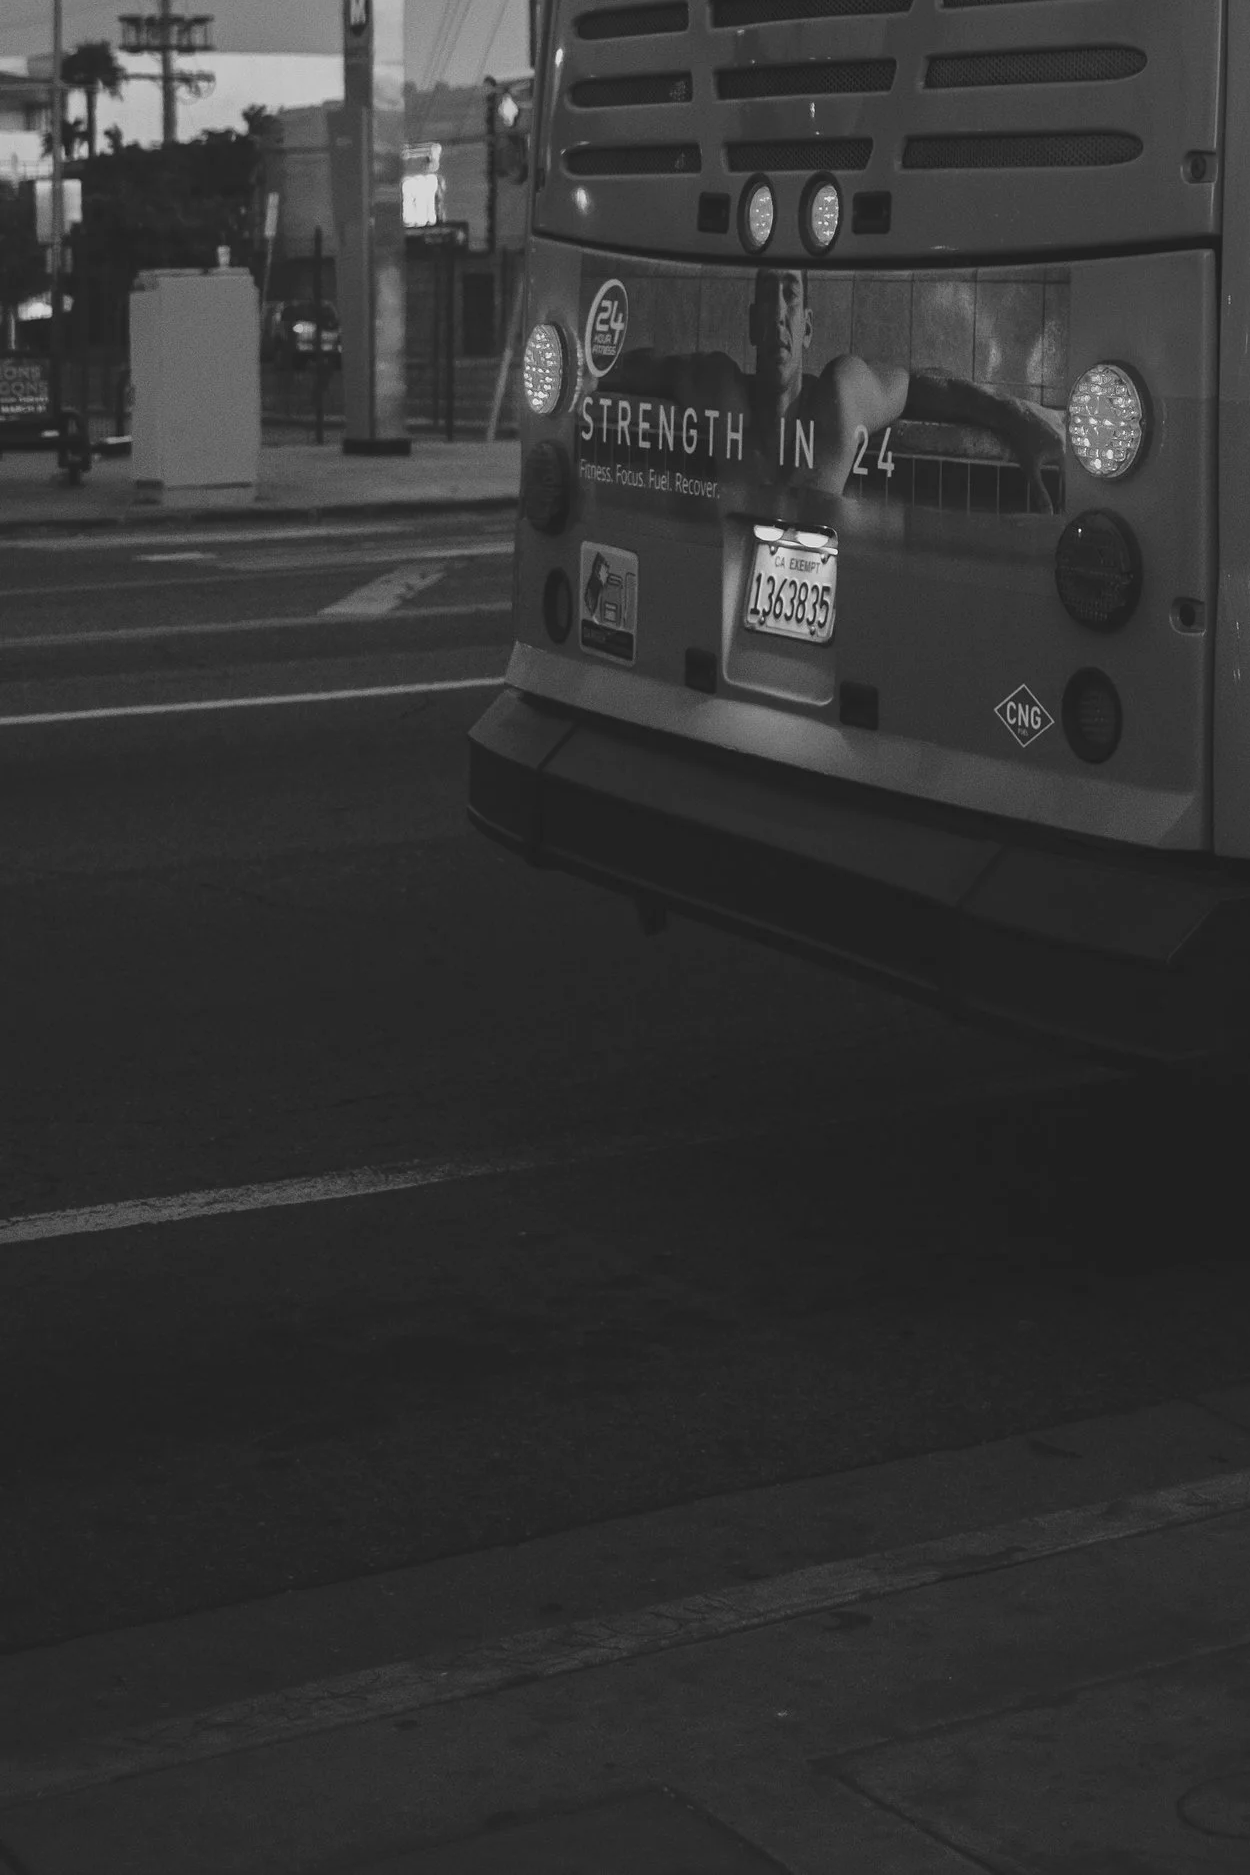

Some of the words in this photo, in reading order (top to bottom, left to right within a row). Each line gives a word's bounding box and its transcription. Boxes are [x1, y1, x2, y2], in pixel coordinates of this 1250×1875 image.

[595, 299, 625, 345] 24
[0, 365, 42, 381] ONS
[581, 396, 744, 461] STRENGTH
[779, 417, 815, 470] IN
[852, 424, 895, 478] 24
[579, 458, 614, 483] Fitness.
[615, 463, 646, 488] Focus.
[648, 468, 673, 492] Fuel.
[675, 472, 721, 499] Recover.
[774, 555, 786, 569] CA
[789, 557, 821, 574] EXEMPT
[749, 572, 831, 629] 1363835
[1006, 700, 1042, 730] CNG
